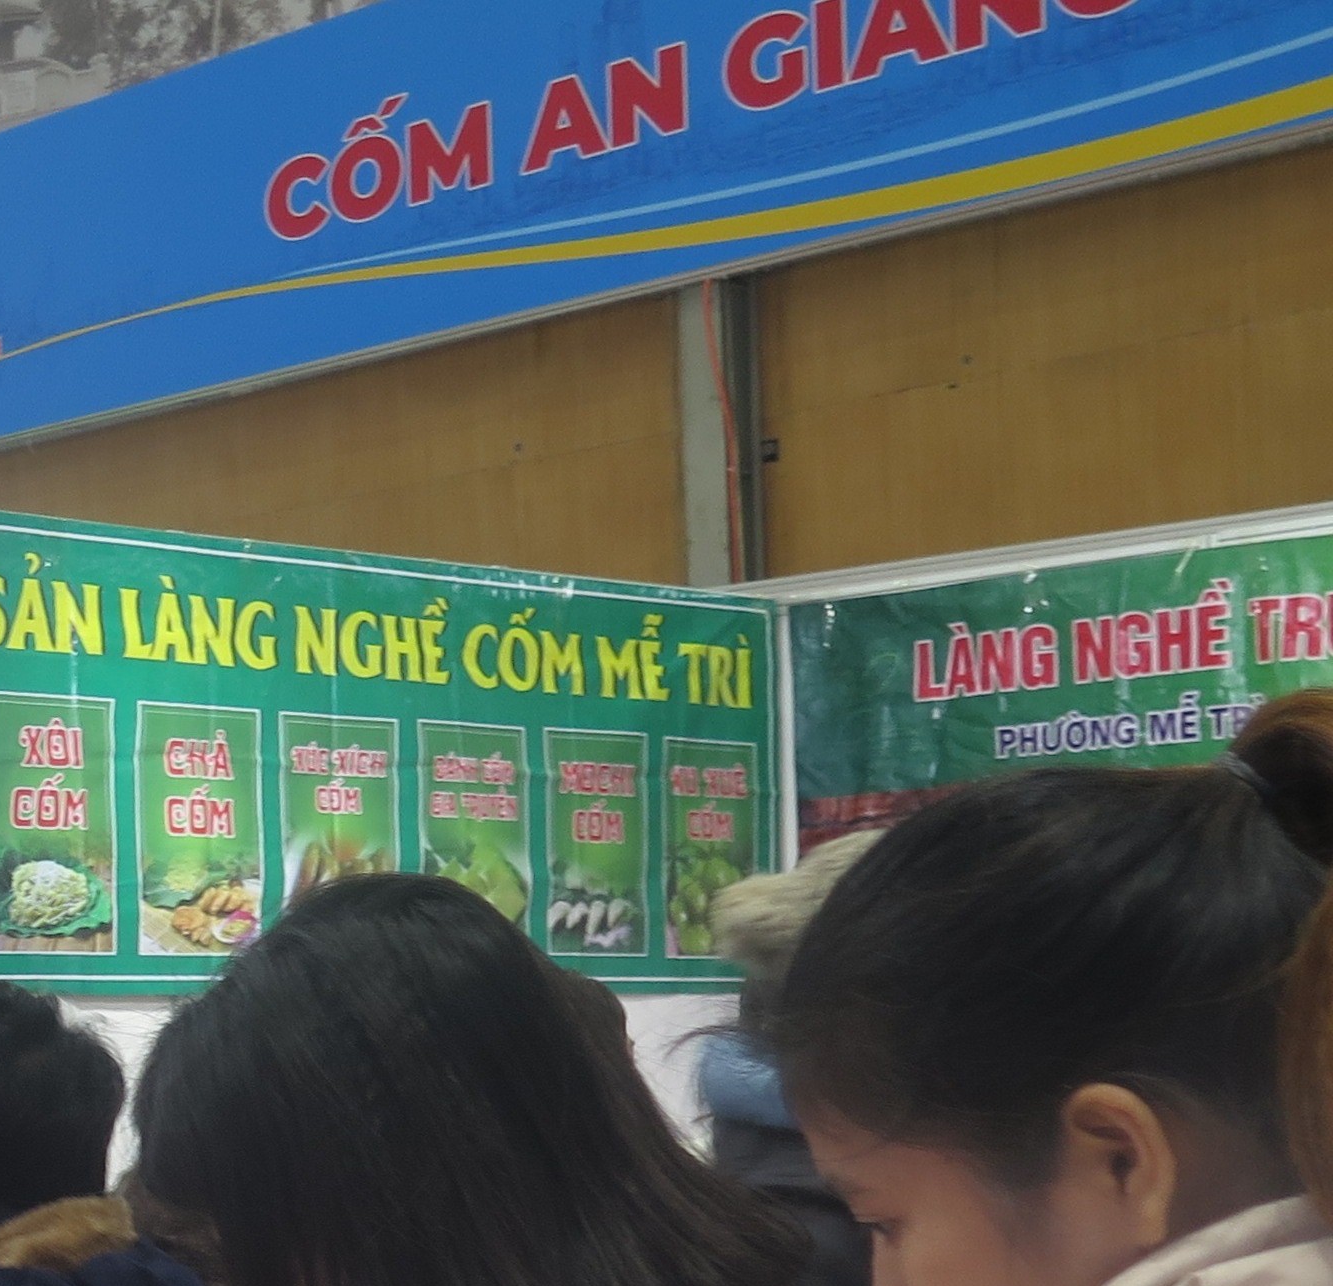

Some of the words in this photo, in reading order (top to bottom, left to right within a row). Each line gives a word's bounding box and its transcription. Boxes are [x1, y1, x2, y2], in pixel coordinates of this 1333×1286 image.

[264, 93, 494, 242] CỐM
[521, 42, 689, 177] AN
[721, 0, 1134, 112] GIA
[119, 574, 278, 671] LÀNG
[294, 598, 450, 686] NGHỀ
[462, 607, 586, 696] CỐM
[595, 613, 670, 702] MỄ
[678, 633, 752, 709] TRÌ
[913, 622, 1060, 703] LÀNG
[1072, 578, 1232, 684] NGHỀ
[18, 717, 85, 770] XÔI
[995, 712, 1139, 759] PHƯỜNG
[1147, 690, 1202, 746] MỄ
[163, 729, 235, 780] CHẢ
[559, 761, 636, 798] MOCHI
[10, 773, 89, 830] CỐM
[164, 784, 236, 838] CỐM
[314, 777, 364, 815] CỐM
[573, 799, 624, 844] CỐM
[687, 800, 733, 842] CỐM
